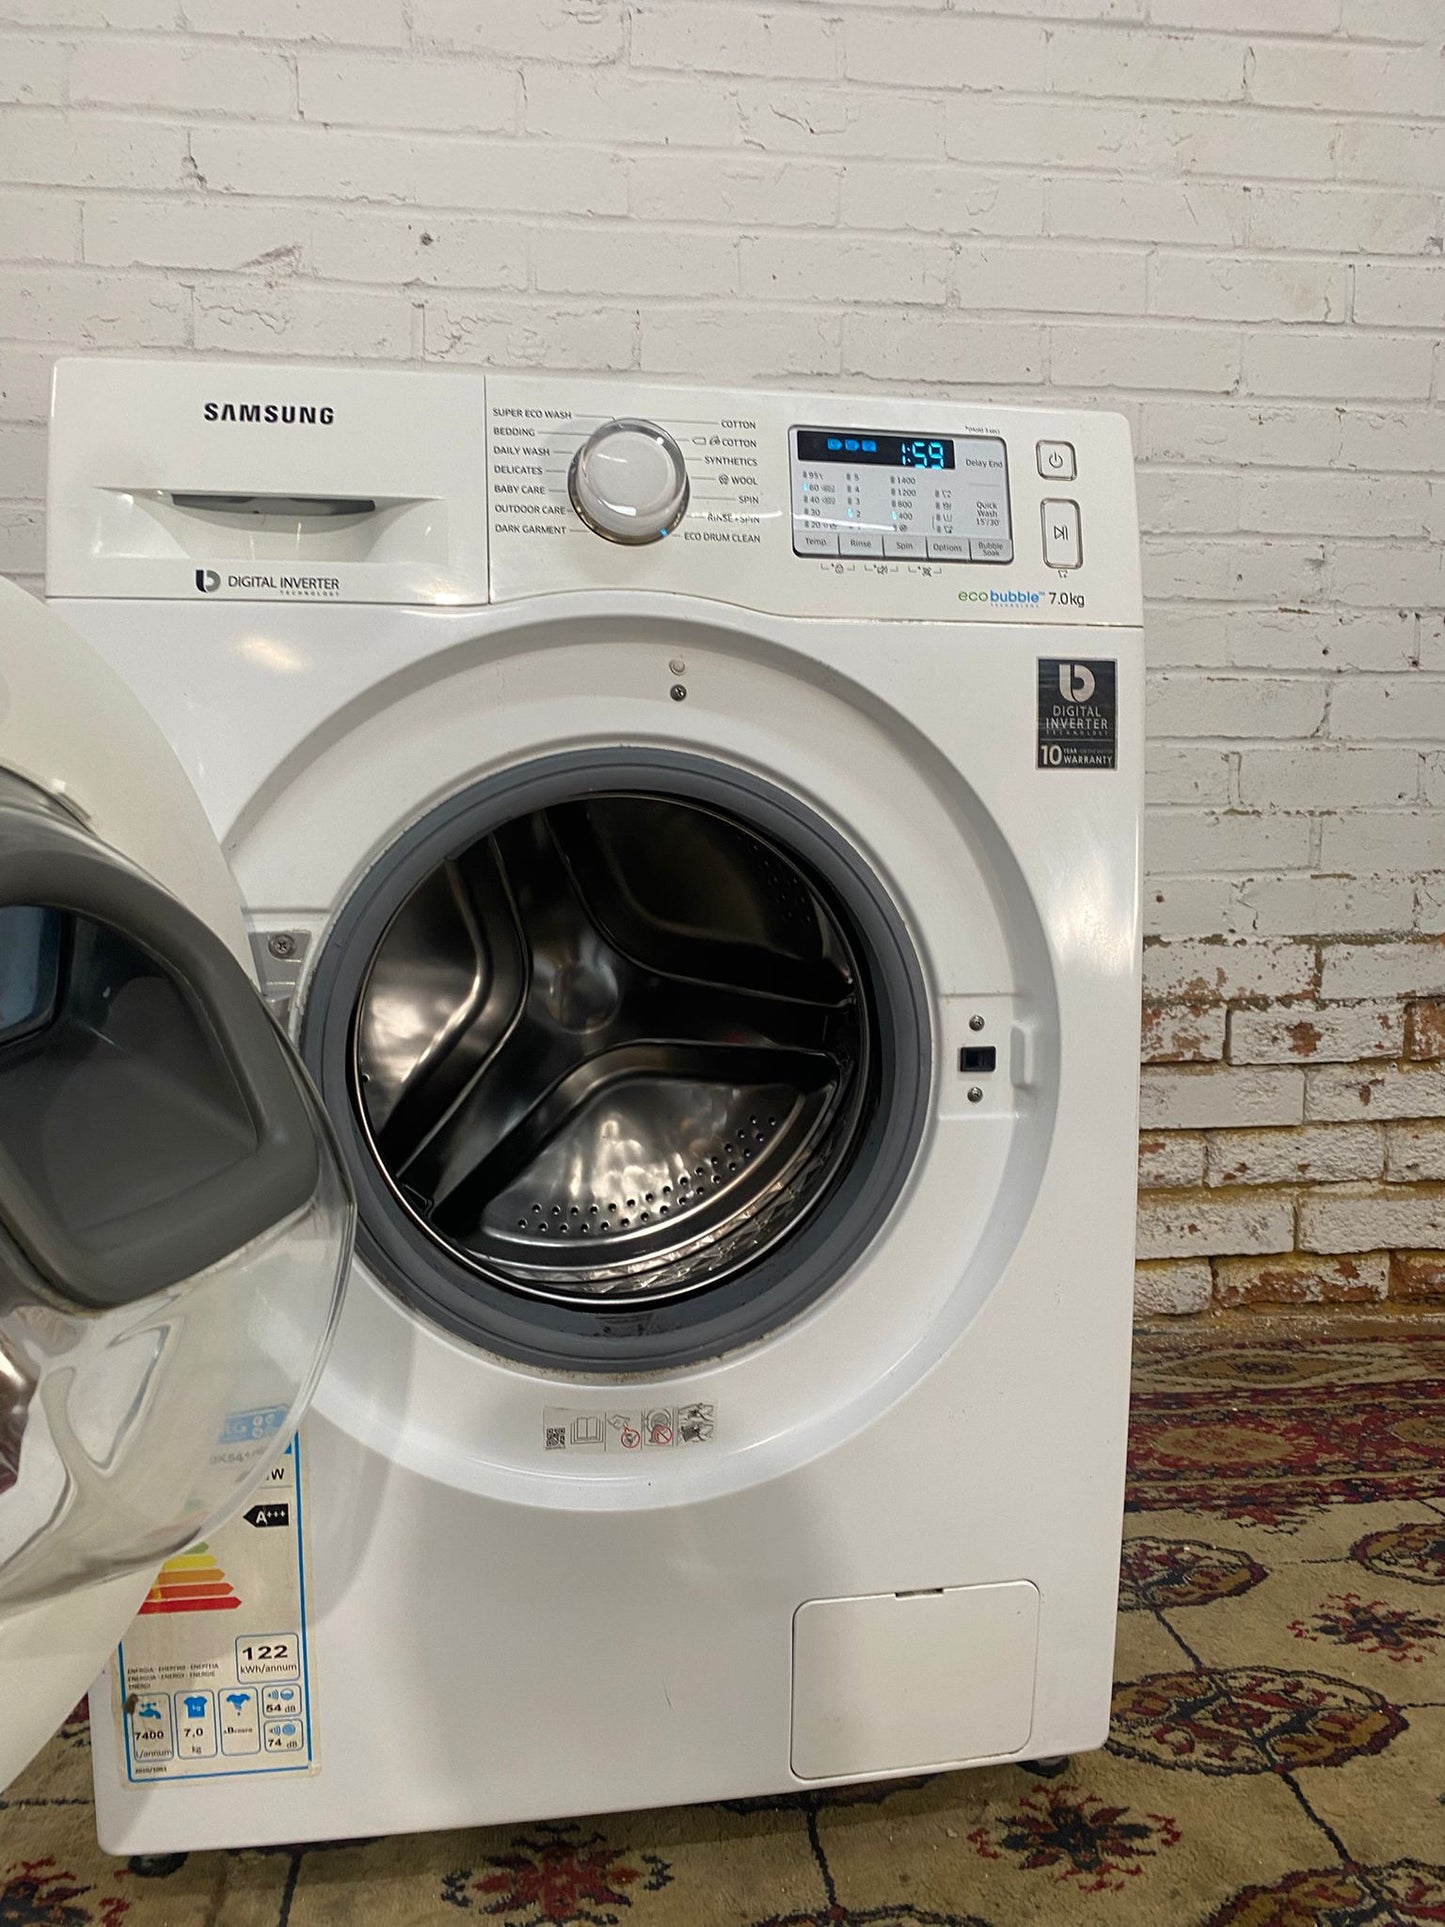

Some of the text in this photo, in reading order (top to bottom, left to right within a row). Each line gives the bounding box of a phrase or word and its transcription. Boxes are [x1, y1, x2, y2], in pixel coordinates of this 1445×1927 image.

[203, 402, 336, 425] SAMSUNG
[492, 408, 573, 420] SUPER ECO WASH
[721, 419, 757, 430] COTTON
[493, 427, 536, 437] BEDDING
[722, 437, 757, 448] COTTON
[493, 445, 550, 456] DAILY WASH
[901, 441, 944, 470] 1:59
[704, 456, 758, 467] SYNTHETICS
[965, 458, 1003, 468] Delay End
[494, 465, 543, 475] DELICATES
[731, 476, 759, 486] WOOL
[897, 476, 916, 484] 1400
[494, 484, 546, 495] BABY CARE
[809, 484, 820, 492] 60
[854, 486, 860, 494] 4
[897, 488, 916, 497] 1200
[738, 496, 760, 504] SPIN
[810, 496, 820, 504] 40
[855, 498, 860, 506] 3
[495, 504, 567, 515] OUTDOOR CARE
[976, 501, 998, 510] Quick
[810, 508, 820, 516] 30
[856, 510, 861, 518] 2
[898, 512, 913, 520] 400
[977, 510, 998, 518] Wash
[707, 513, 733, 523] RINSE
[495, 524, 567, 535] DARK GARMENT
[684, 532, 761, 544] ECO DRUM CLEAN
[850, 539, 872, 548] Rinse
[896, 542, 913, 550] Spin
[933, 542, 962, 552] Options
[978, 542, 1004, 550] Bubble
[228, 575, 340, 590] DIGITAL INVERTER
[1053, 705, 1102, 717] DIGITAL
[1046, 717, 1108, 729] INVERTER
[1041, 744, 1062, 766] 10
[1064, 756, 1113, 766] WARRANTY
[256, 1510, 286, 1524] A+++
[242, 1644, 288, 1661] 122
[240, 1662, 298, 1675] kWh/annum
[266, 1704, 296, 1714] 54 dB
[135, 1730, 165, 1741] 7400
[184, 1728, 204, 1738] 7,0
[192, 1744, 202, 1754] kg
[267, 1738, 298, 1750] 74 dB
